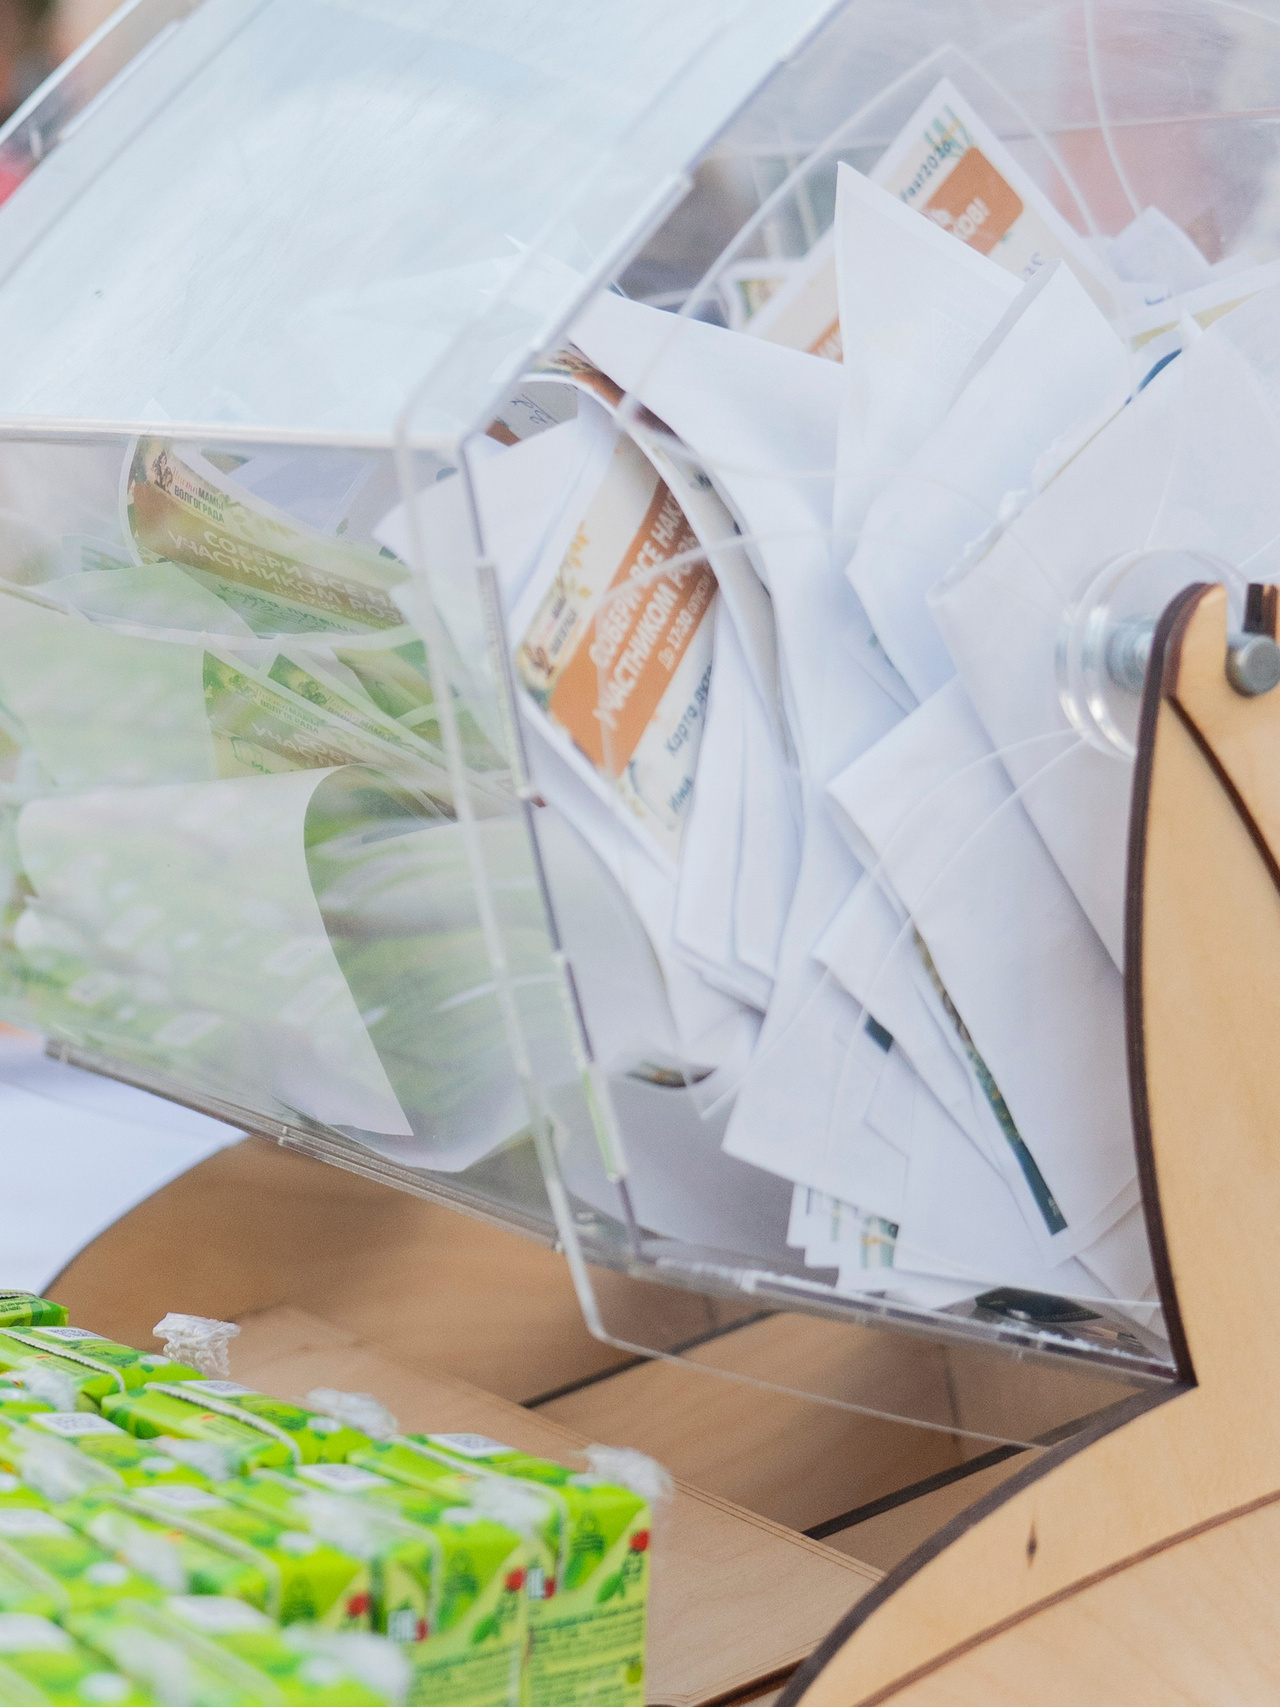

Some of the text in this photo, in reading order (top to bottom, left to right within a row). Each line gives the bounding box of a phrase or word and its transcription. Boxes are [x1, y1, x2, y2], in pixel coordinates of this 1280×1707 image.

[175, 485, 224, 523] ВОЛГОГРАДА
[168, 531, 342, 604] УЧАСТНИКОМ
[204, 530, 303, 578] СОБЕРИ
[311, 571, 357, 597] ВСЕ
[589, 586, 643, 668] СОБЕРИ
[593, 582, 678, 730] УЧАСТНИКОМ
[665, 703, 699, 757] Карта
